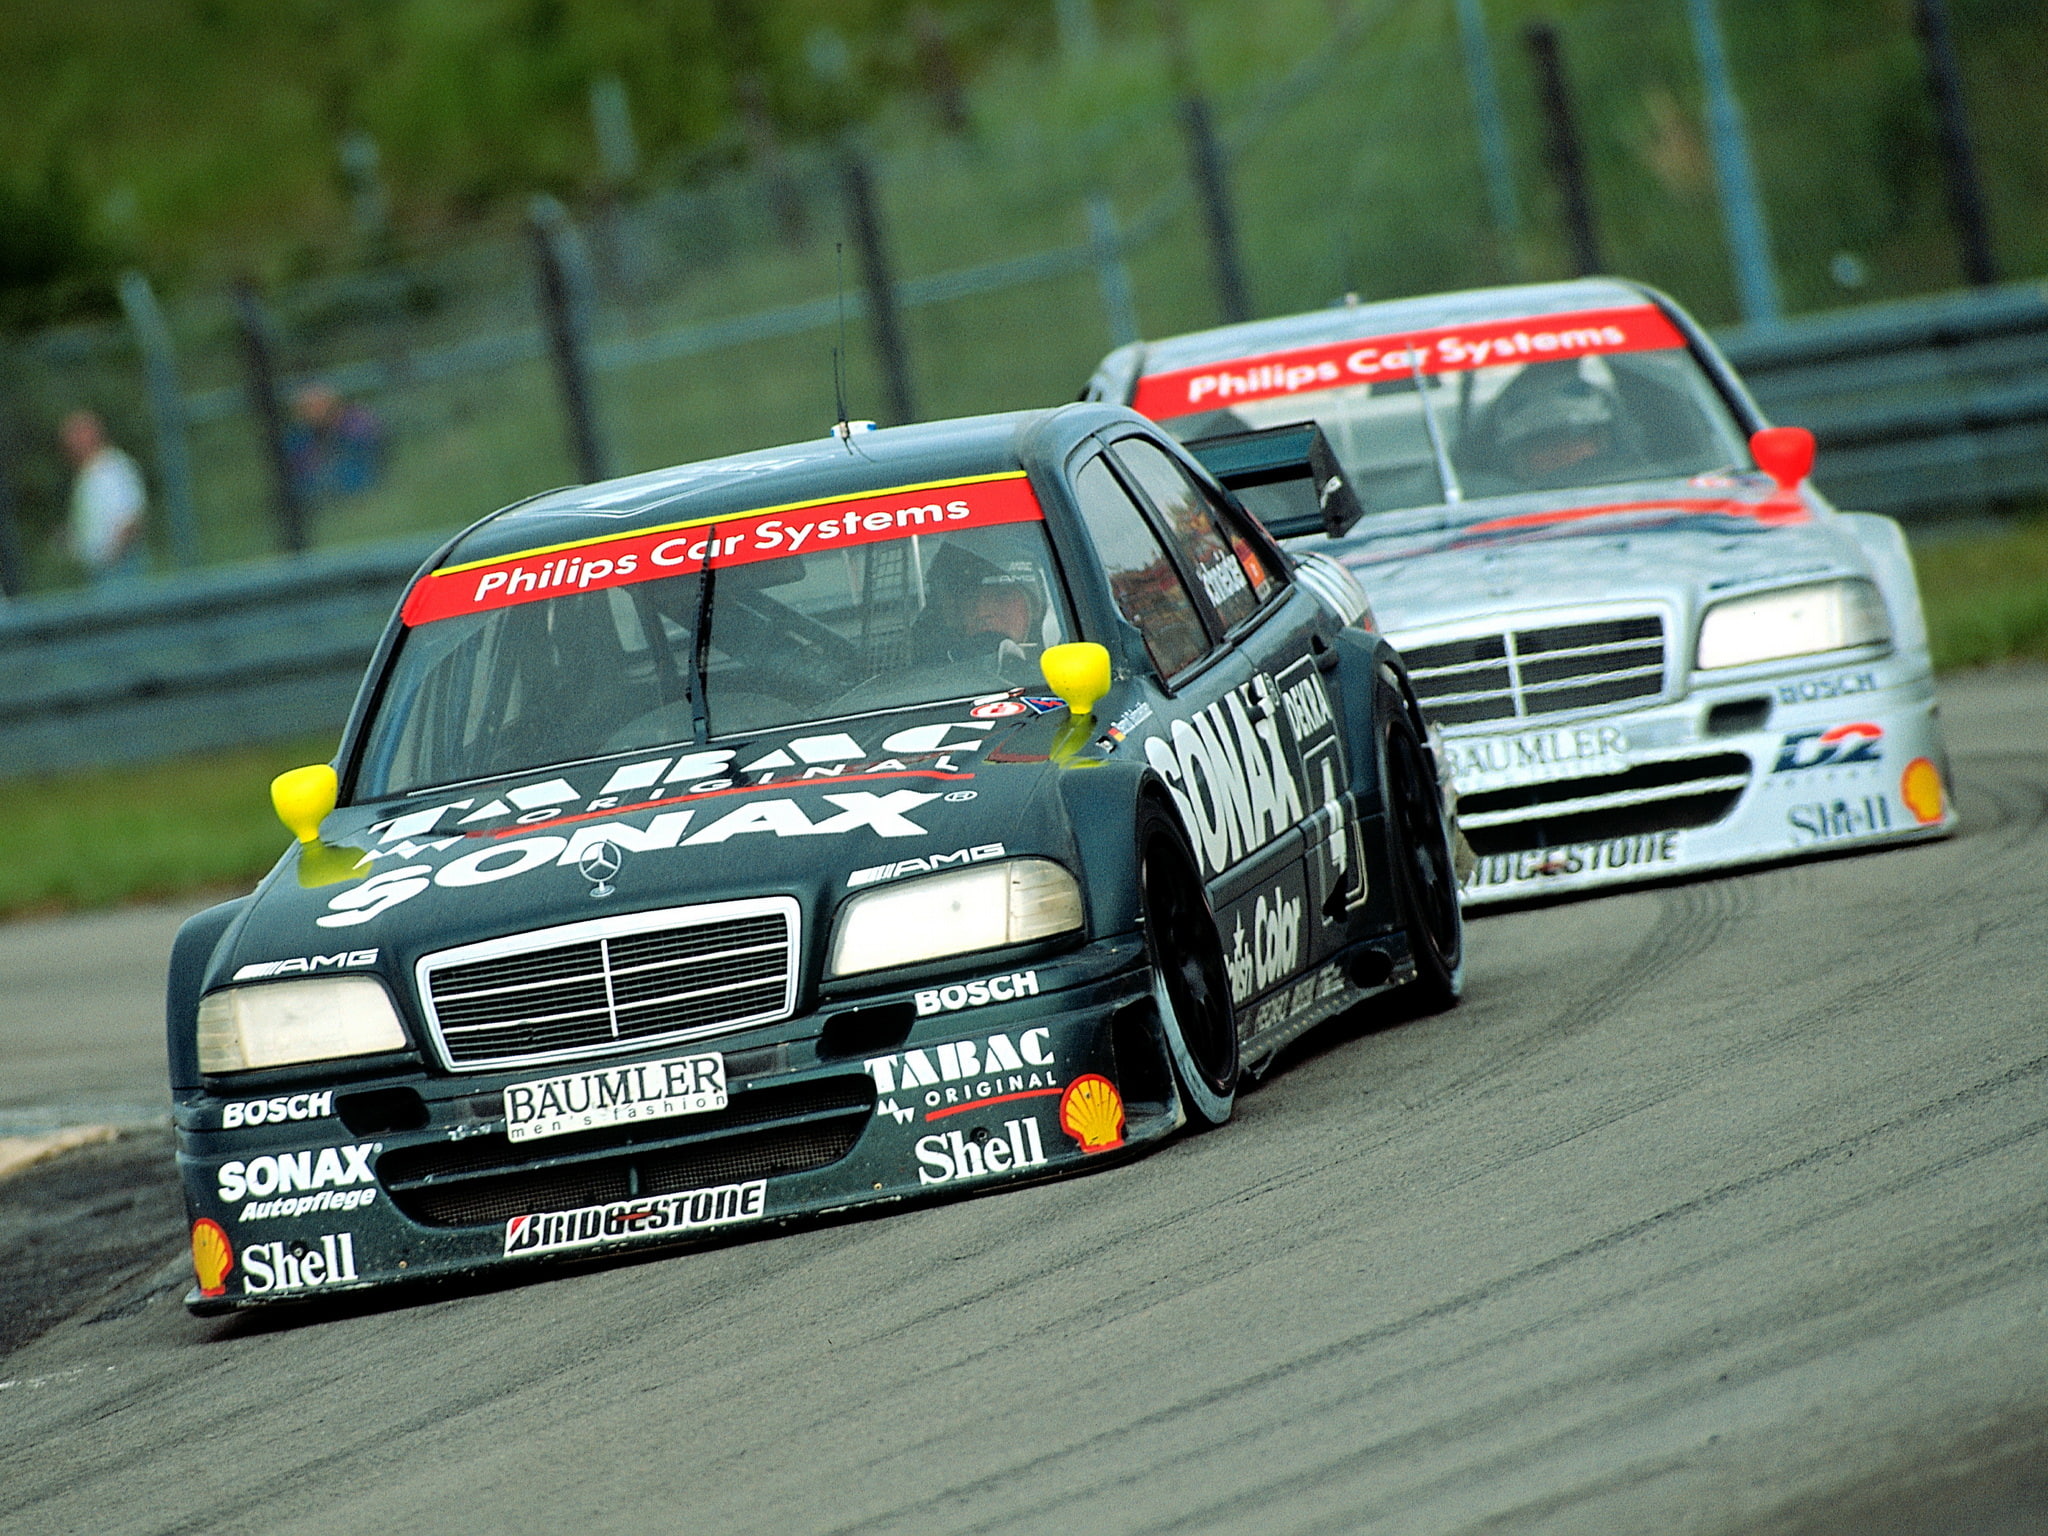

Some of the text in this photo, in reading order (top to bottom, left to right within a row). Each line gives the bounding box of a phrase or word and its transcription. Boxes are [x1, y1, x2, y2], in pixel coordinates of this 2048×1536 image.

[1188, 326, 1625, 403] Philips Car Systems
[474, 500, 971, 602] Philips Car Systems
[1778, 673, 1876, 705] BOSCH
[367, 720, 996, 845] TABAC
[516, 755, 959, 825] ORIGINAL
[893, 842, 1006, 878] AMG
[270, 948, 379, 977] AMG
[1255, 886, 1301, 990] Color
[914, 970, 1040, 1017] BOSCH
[507, 1057, 723, 1124] BÄUMLER
[864, 1027, 1055, 1095] TABAC
[925, 1070, 1057, 1107] ORIGINAL
[222, 1091, 333, 1129] BOSCH
[511, 1094, 726, 1139] men's fashion
[914, 1116, 1048, 1186] Shell
[238, 1188, 377, 1223] Autopflege
[507, 1184, 762, 1253] BRIDGESTONE
[241, 1232, 359, 1294] Shell
